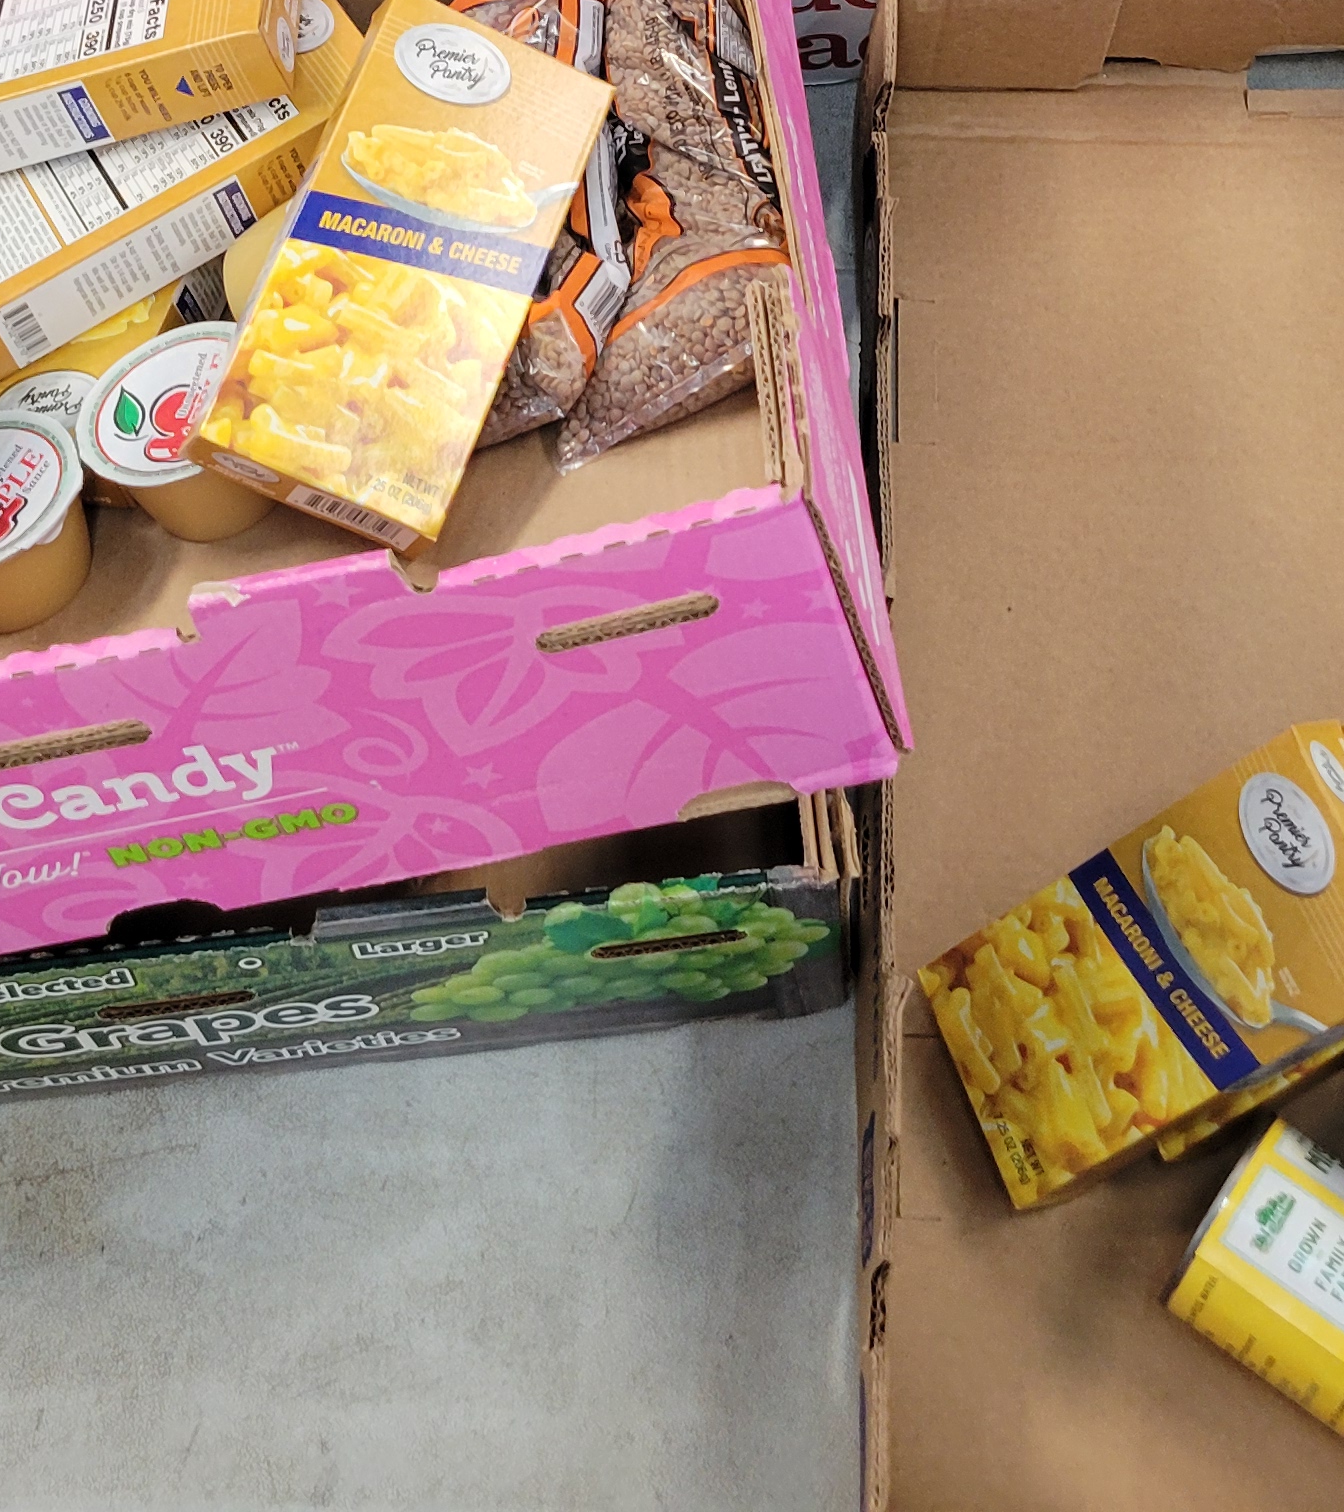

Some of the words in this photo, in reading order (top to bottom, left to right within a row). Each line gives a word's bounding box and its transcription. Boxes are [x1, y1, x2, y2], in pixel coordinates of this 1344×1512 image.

[83, 30, 100, 57] 390
[415, 39, 480, 66] Premier
[430, 60, 487, 90] Pantry
[210, 128, 234, 153] 390
[319, 211, 425, 250] MACARONI
[428, 236, 444, 253] &
[448, 241, 522, 274] CHEESE
[21, 459, 51, 495] Sauce
[105, 801, 360, 870] NON-GMO
[1261, 788, 1312, 850] Premier
[1259, 817, 1306, 870] Pantry
[351, 928, 491, 962] Larger
[1093, 876, 1165, 972] MACARONI
[1155, 971, 1175, 990] &
[1168, 988, 1233, 1060] CHEESE
[209, 1026, 463, 1069] Varieties
